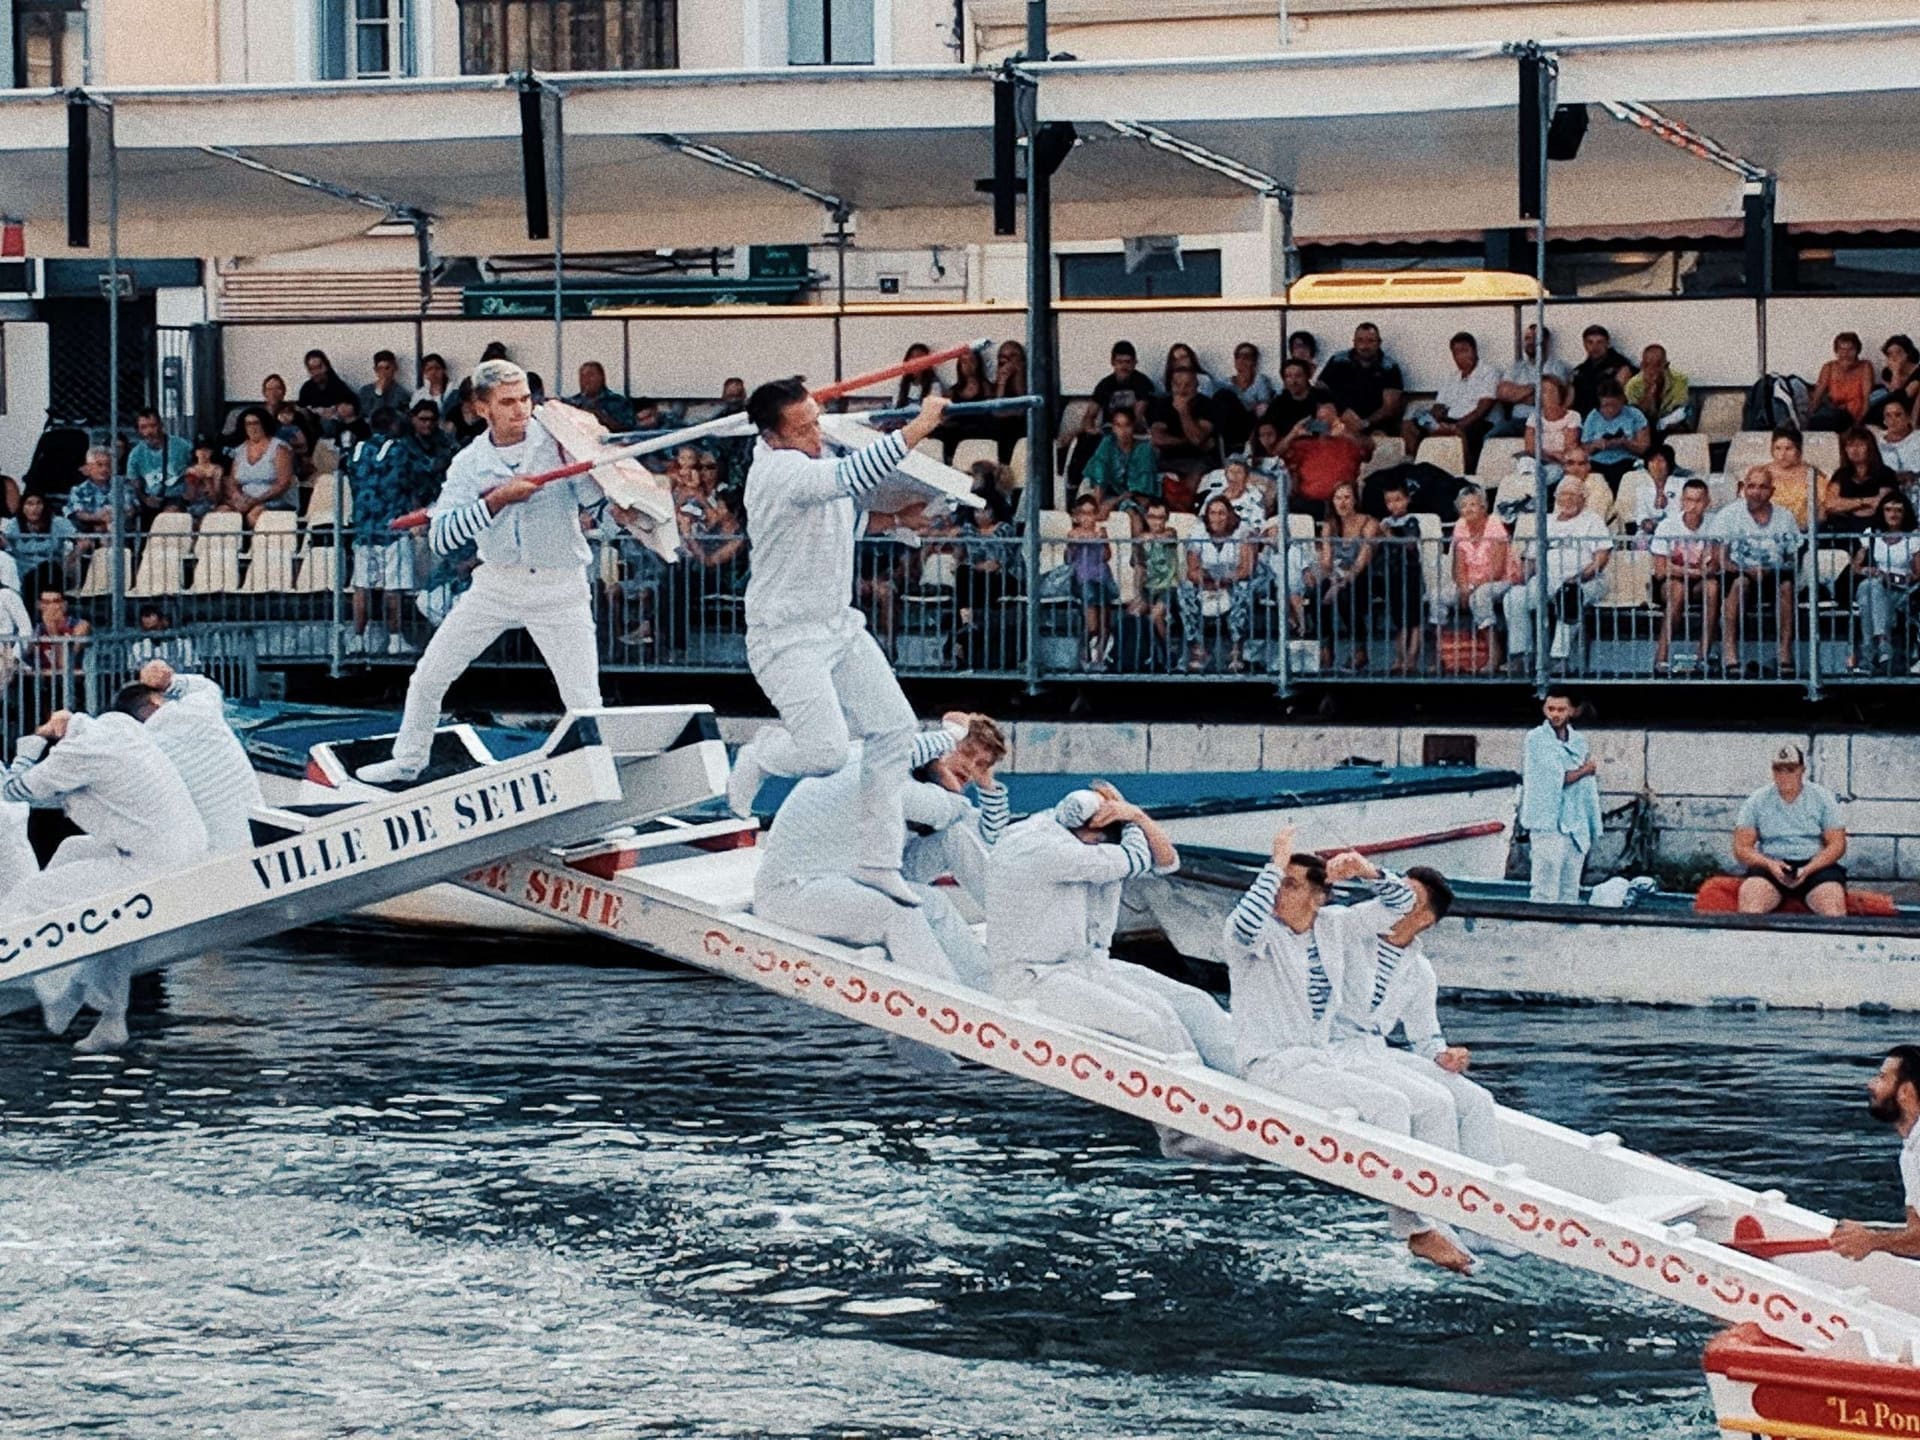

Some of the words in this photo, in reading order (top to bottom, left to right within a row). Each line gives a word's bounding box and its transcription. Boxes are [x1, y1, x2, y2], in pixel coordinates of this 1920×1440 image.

[252, 827, 366, 889] VILLE
[383, 806, 437, 850] DE
[454, 770, 557, 829] SETE
[526, 869, 623, 929] SETE
